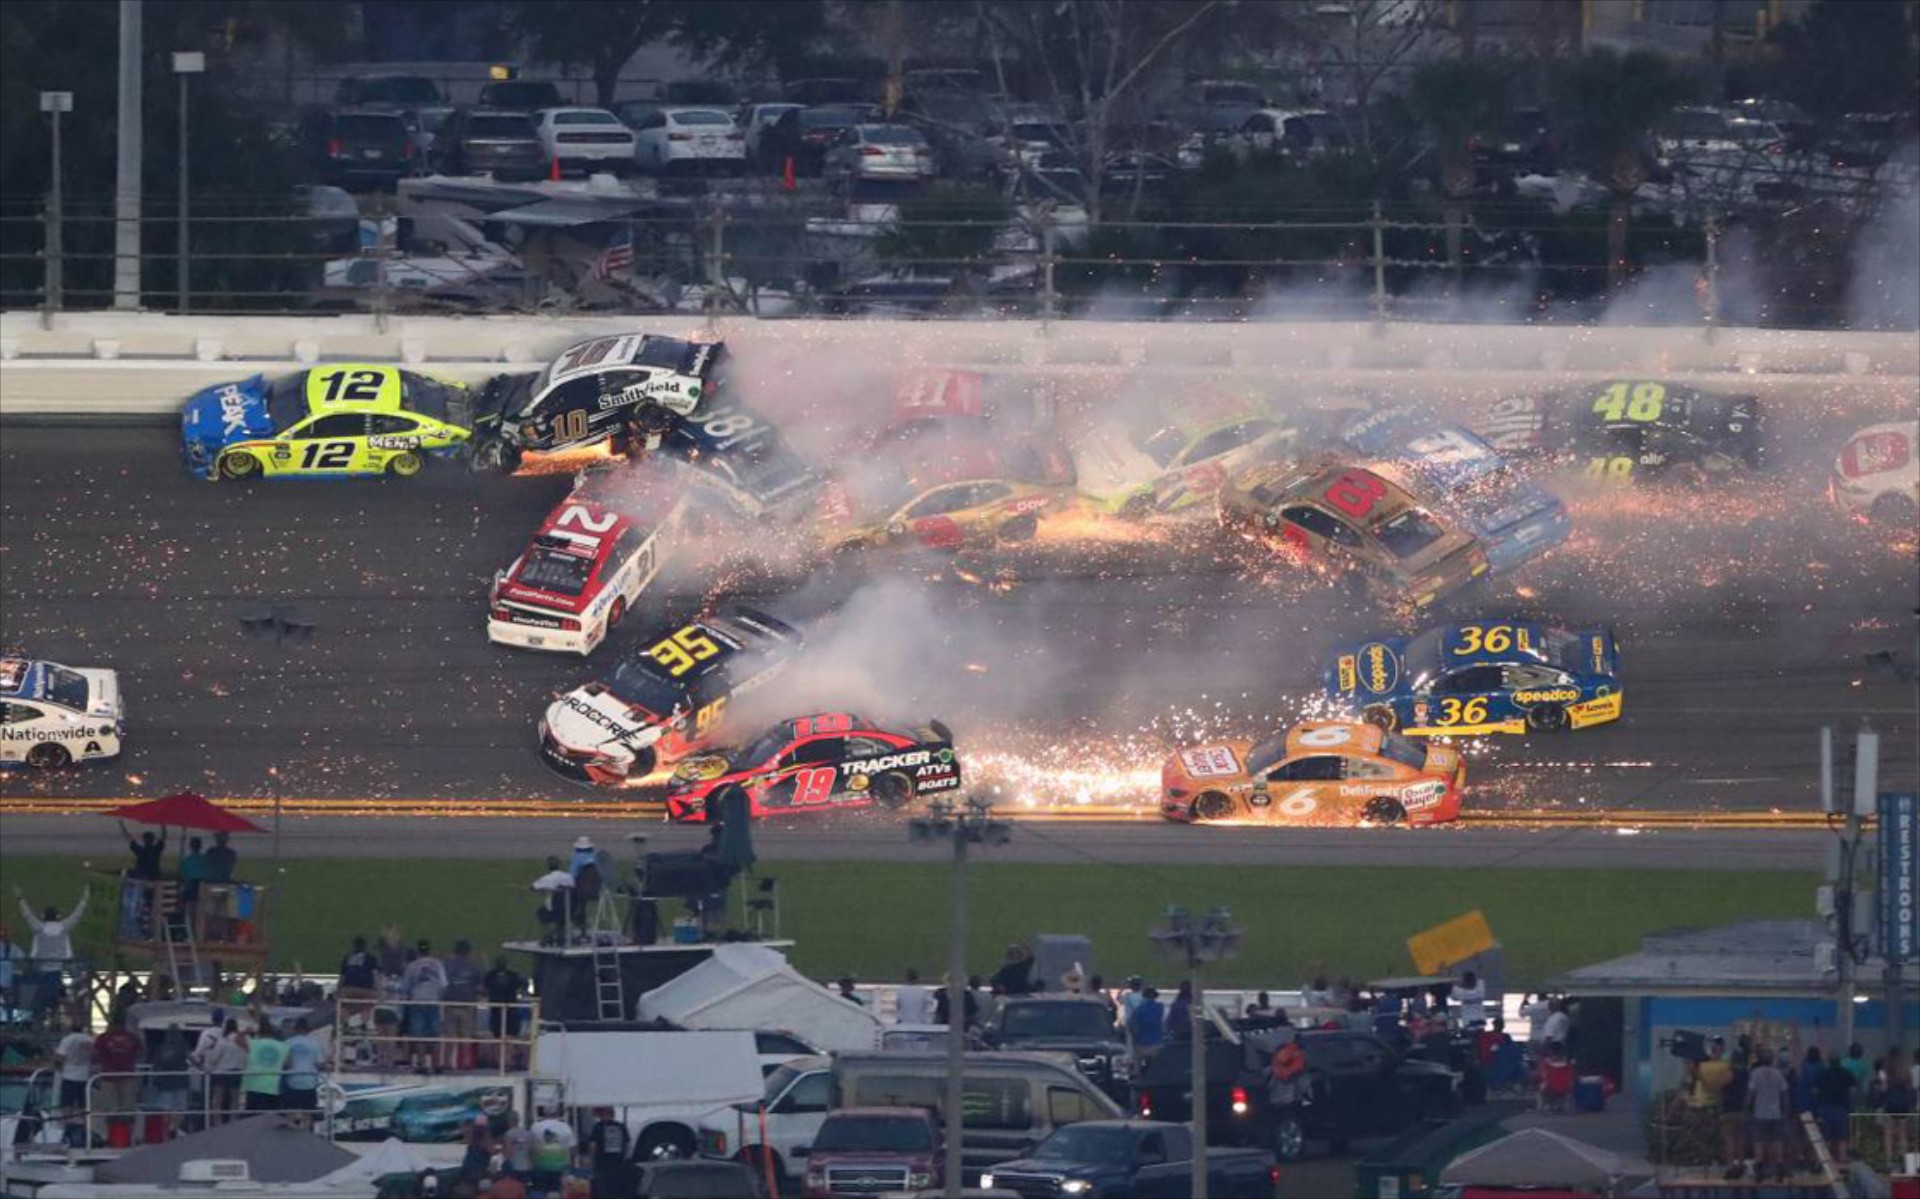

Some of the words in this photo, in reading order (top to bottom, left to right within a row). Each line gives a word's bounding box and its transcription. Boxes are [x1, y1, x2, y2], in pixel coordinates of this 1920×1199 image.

[320, 370, 386, 402] 12
[599, 381, 681, 410] Smithfield
[213, 384, 247, 437] PEAK
[1593, 382, 1666, 422] 48
[552, 409, 589, 445] 10
[301, 441, 356, 469] 12
[650, 625, 720, 677] 95
[1454, 625, 1513, 656] 36
[1437, 697, 1490, 726] 36
[1515, 689, 1577, 705] speedco
[1, 725, 95, 741] Nationwide
[697, 696, 727, 742] 95
[1299, 726, 1351, 747] 6
[840, 751, 930, 775] TRACKER
[916, 764, 952, 778] ATVs
[791, 767, 837, 805] 19
[917, 777, 958, 791] BOATS
[1405, 785, 1435, 799] Oscar
[1280, 788, 1318, 817] 6
[1404, 793, 1437, 808] Mayer
[1898, 813, 1912, 956] RESTROOMS
